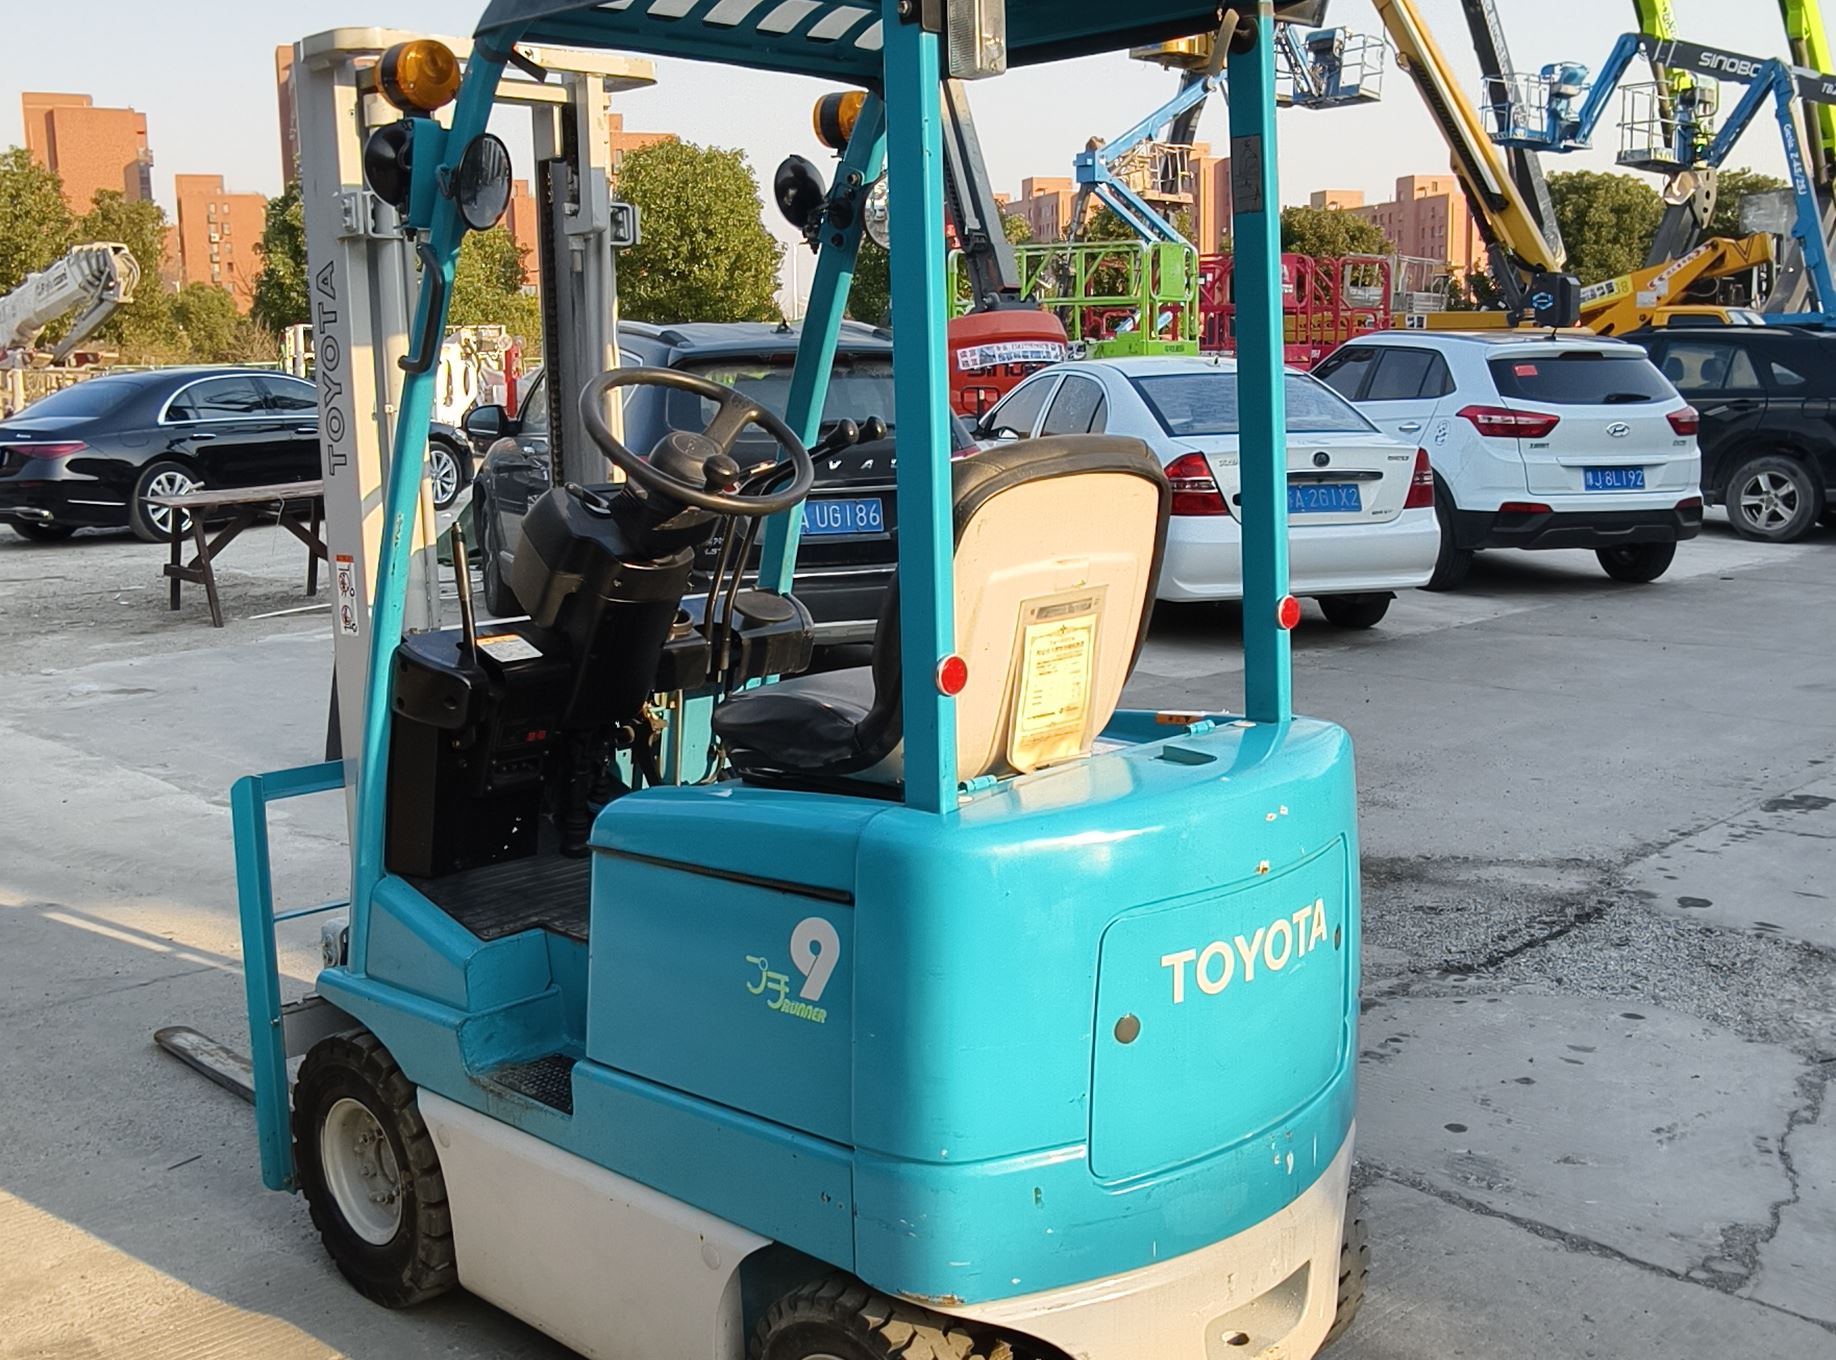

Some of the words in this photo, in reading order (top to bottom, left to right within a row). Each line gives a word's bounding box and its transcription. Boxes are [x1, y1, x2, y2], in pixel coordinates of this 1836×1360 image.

[316, 260, 348, 476] TOYOTA
[790, 916, 840, 1001] 9
[1161, 897, 1328, 1004] TOYOTA
